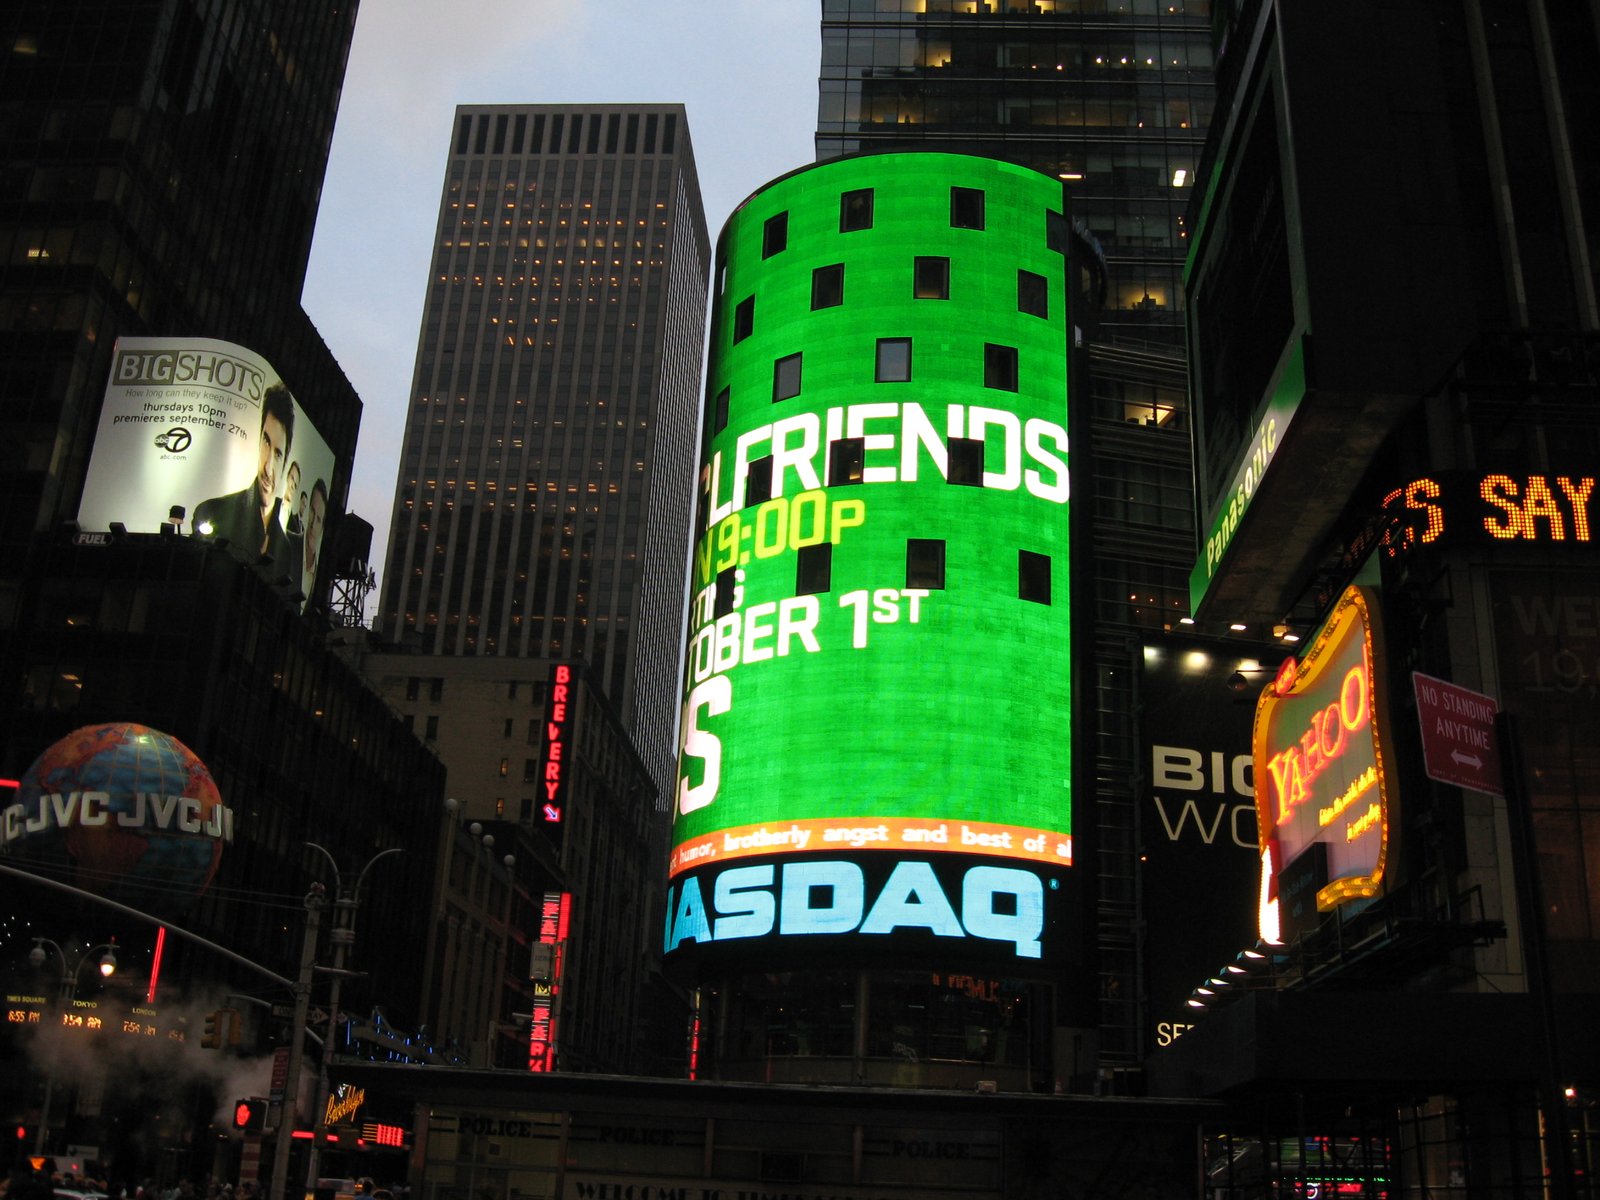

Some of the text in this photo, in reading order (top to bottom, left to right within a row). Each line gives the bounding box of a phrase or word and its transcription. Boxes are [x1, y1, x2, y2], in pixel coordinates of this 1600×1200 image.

[125, 388, 248, 412] How long can they keep it up?
[143, 402, 227, 419] thursdays 10pm
[113, 413, 248, 440] premieres september 27th
[1206, 418, 1277, 578] Panasonic
[1479, 474, 1596, 542] SAY
[78, 534, 107, 545] FUEL
[839, 588, 929, 649] 1ST
[1510, 594, 1600, 637] WE
[1421, 684, 1494, 726] NO STANDING
[1436, 716, 1491, 751] ANYTIME
[25, 791, 110, 833] JVC
[117, 791, 202, 834] JVC
[680, 842, 716, 865] humor,
[724, 825, 812, 852] brotherly
[823, 825, 890, 847] angst
[902, 824, 947, 844] and
[961, 824, 1012, 849] best
[1023, 829, 1046, 852] of
[663, 861, 1044, 959] ASDAQ
[73, 1000, 98, 1009] TOKYO
[132, 1007, 157, 1017] LONDON
[458, 1117, 970, 1160] POLICE POLICE POLICE
